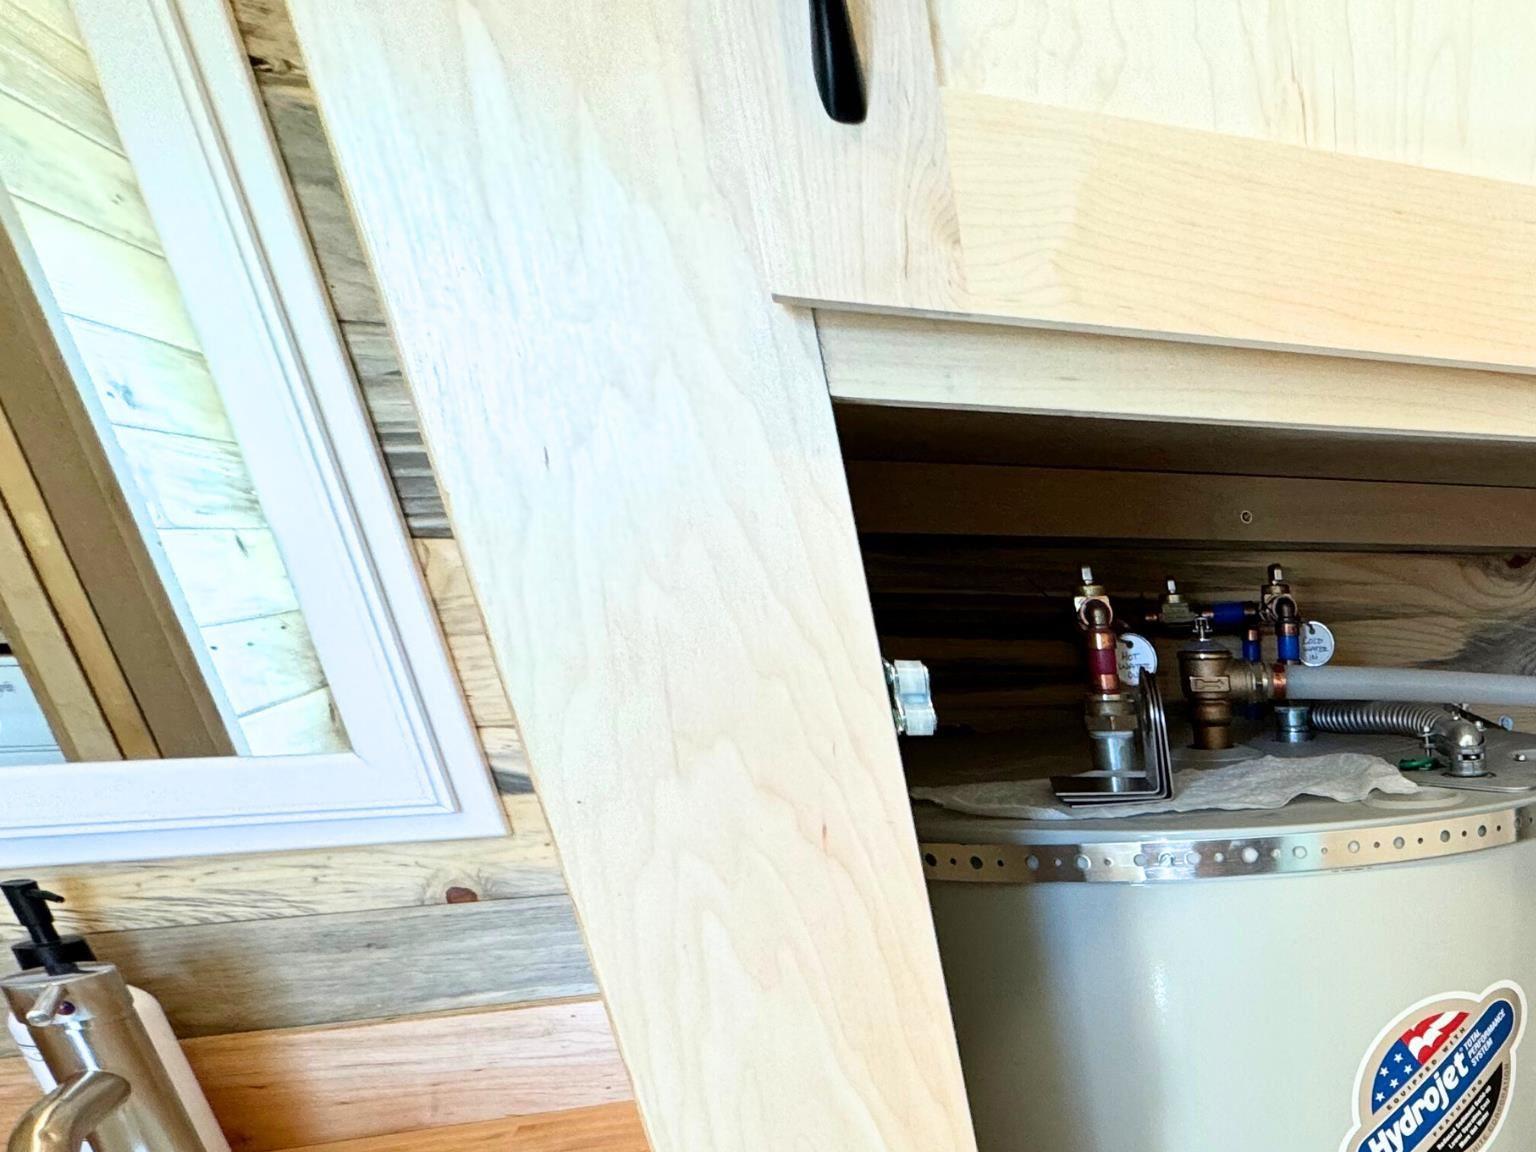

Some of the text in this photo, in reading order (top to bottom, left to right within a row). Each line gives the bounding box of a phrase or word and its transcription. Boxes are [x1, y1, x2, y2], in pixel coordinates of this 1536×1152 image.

[1463, 1029, 1482, 1051] TOTAL
[1467, 1008, 1506, 1059] PERFORMANCE
[1471, 1037, 1494, 1067] SYSTEM
[1386, 1027, 1466, 1111] EQUIPPED WITH
[1433, 1079, 1483, 1137] FEATURING
